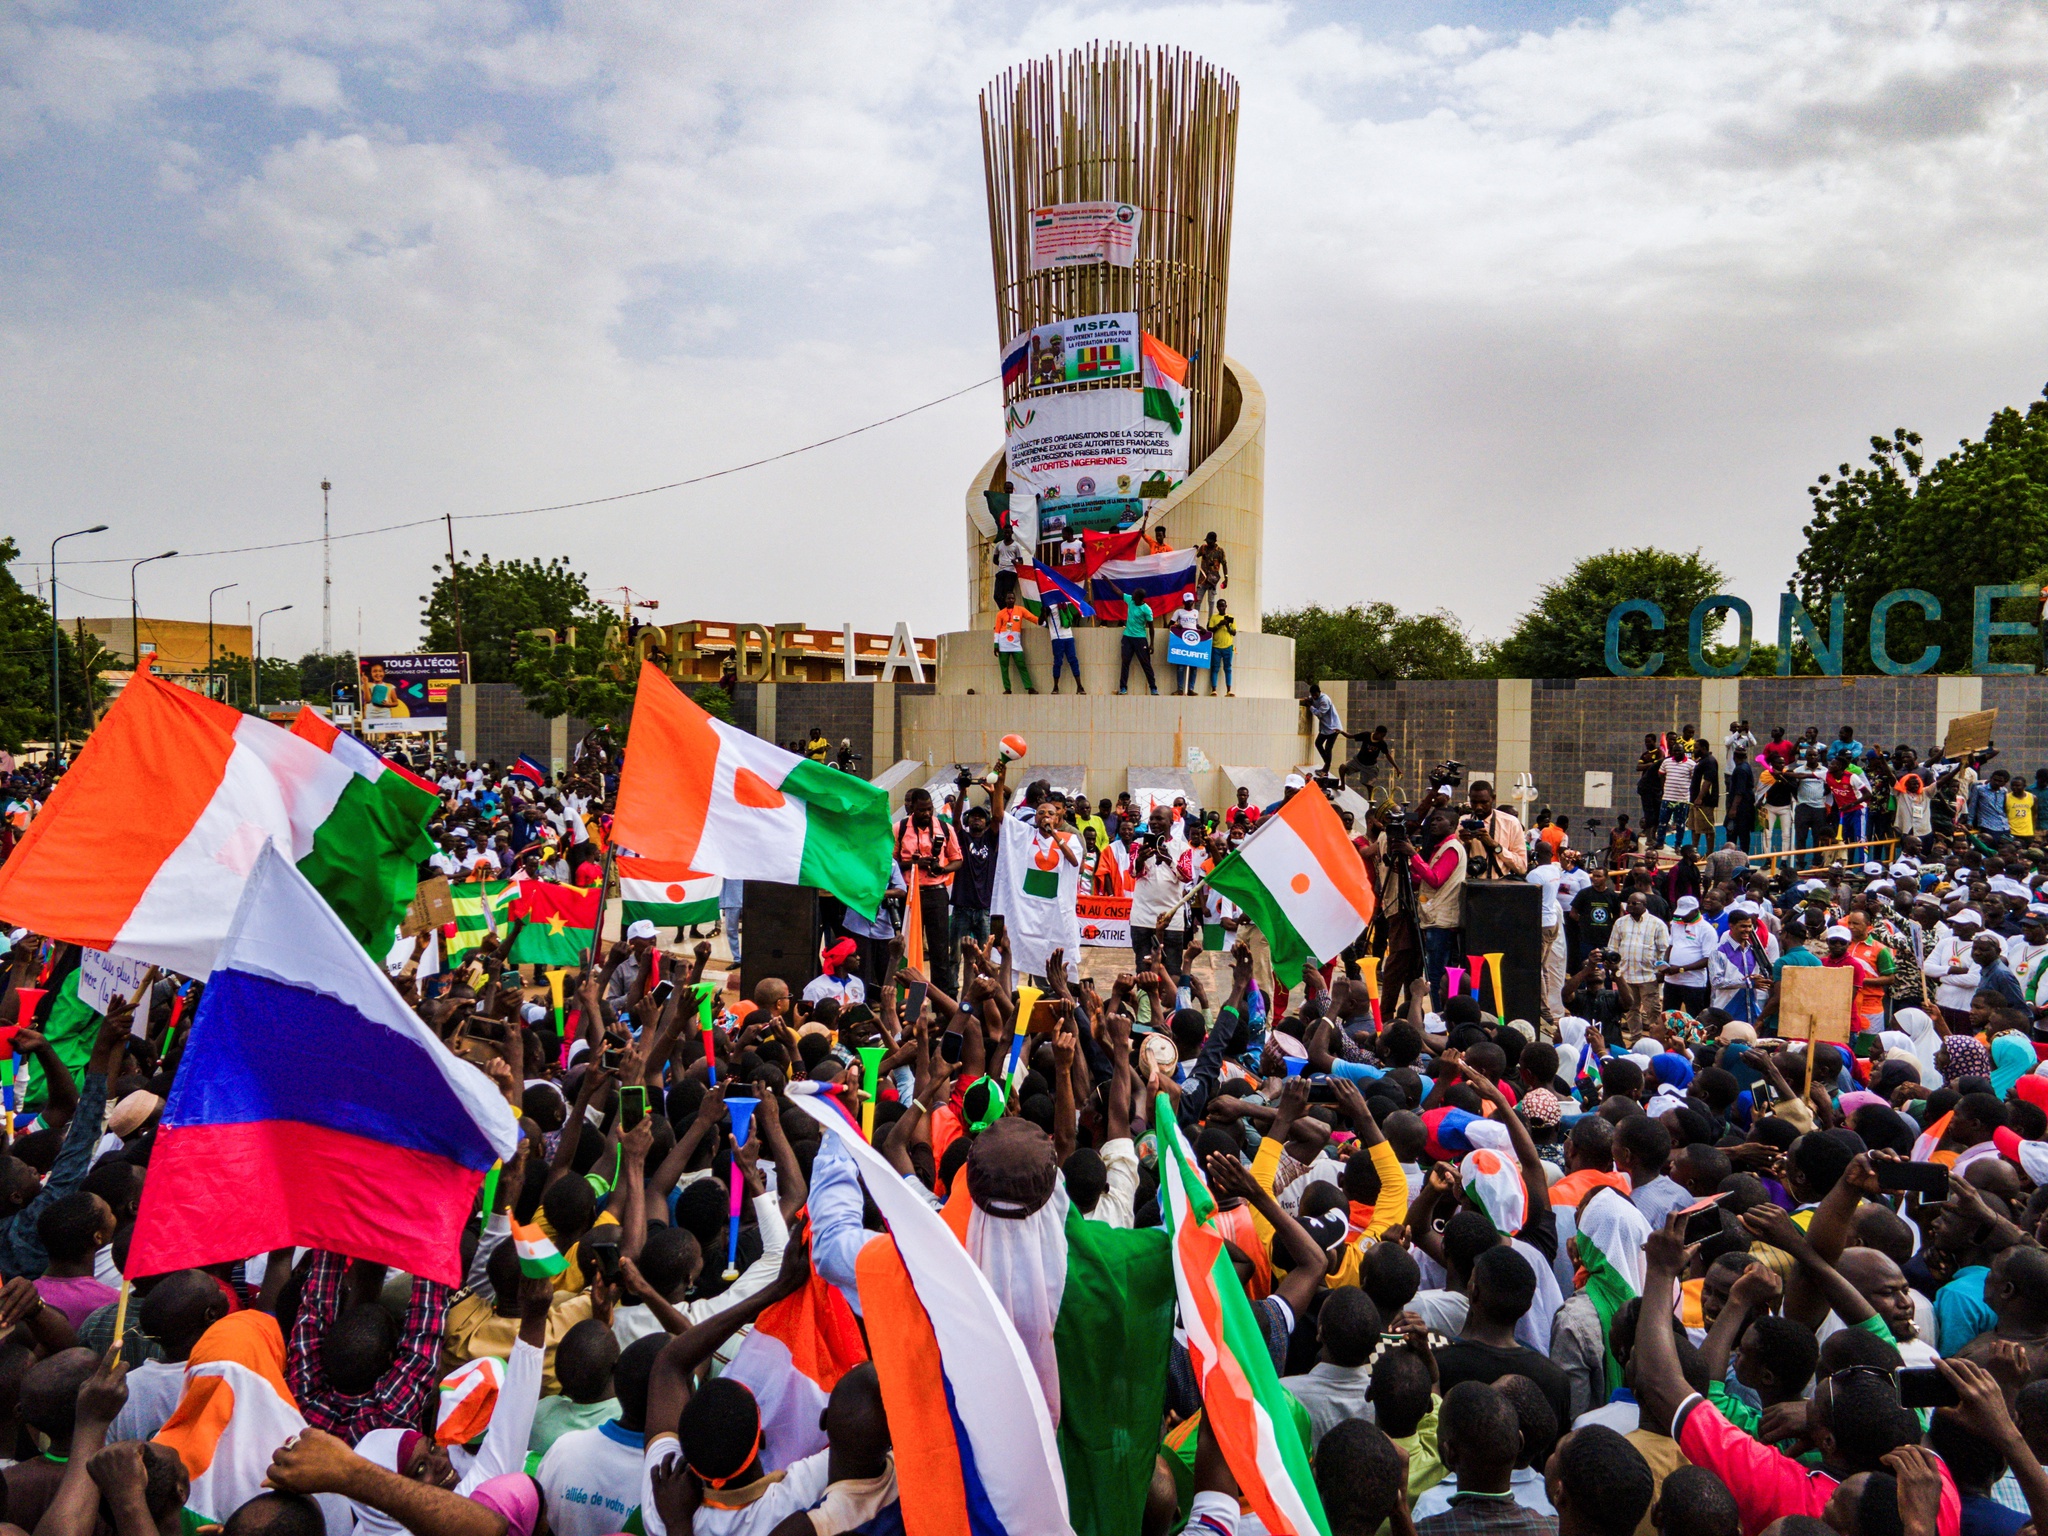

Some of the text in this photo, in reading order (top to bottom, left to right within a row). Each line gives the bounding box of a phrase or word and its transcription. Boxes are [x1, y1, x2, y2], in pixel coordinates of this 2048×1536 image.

[1074, 320, 1120, 333] MSFA
[1066, 333, 1093, 342] MOUVEMENT
[1054, 431, 1109, 443] ORGANISATIONS
[1084, 439, 1124, 447] AUTORITES
[1041, 452, 1074, 461] DECISIONS
[1075, 449, 1099, 457] PRISES
[1132, 447, 1173, 456] NOUVELLES
[1031, 457, 1127, 473] AUTORITES NIGERIENNES
[737, 622, 806, 682] DE
[844, 621, 926, 683] LA
[1171, 648, 1209, 660] SECURITÉ
[383, 657, 458, 668] TOUS À L'ÉCOL
[2015, 810, 2026, 818] 23
[1088, 906, 1101, 916] AU
[1080, 928, 1126, 940] LA PATRIE
[116, 960, 131, 990] plus
[591, 1491, 603, 1506] de
[605, 1498, 624, 1514] votre
